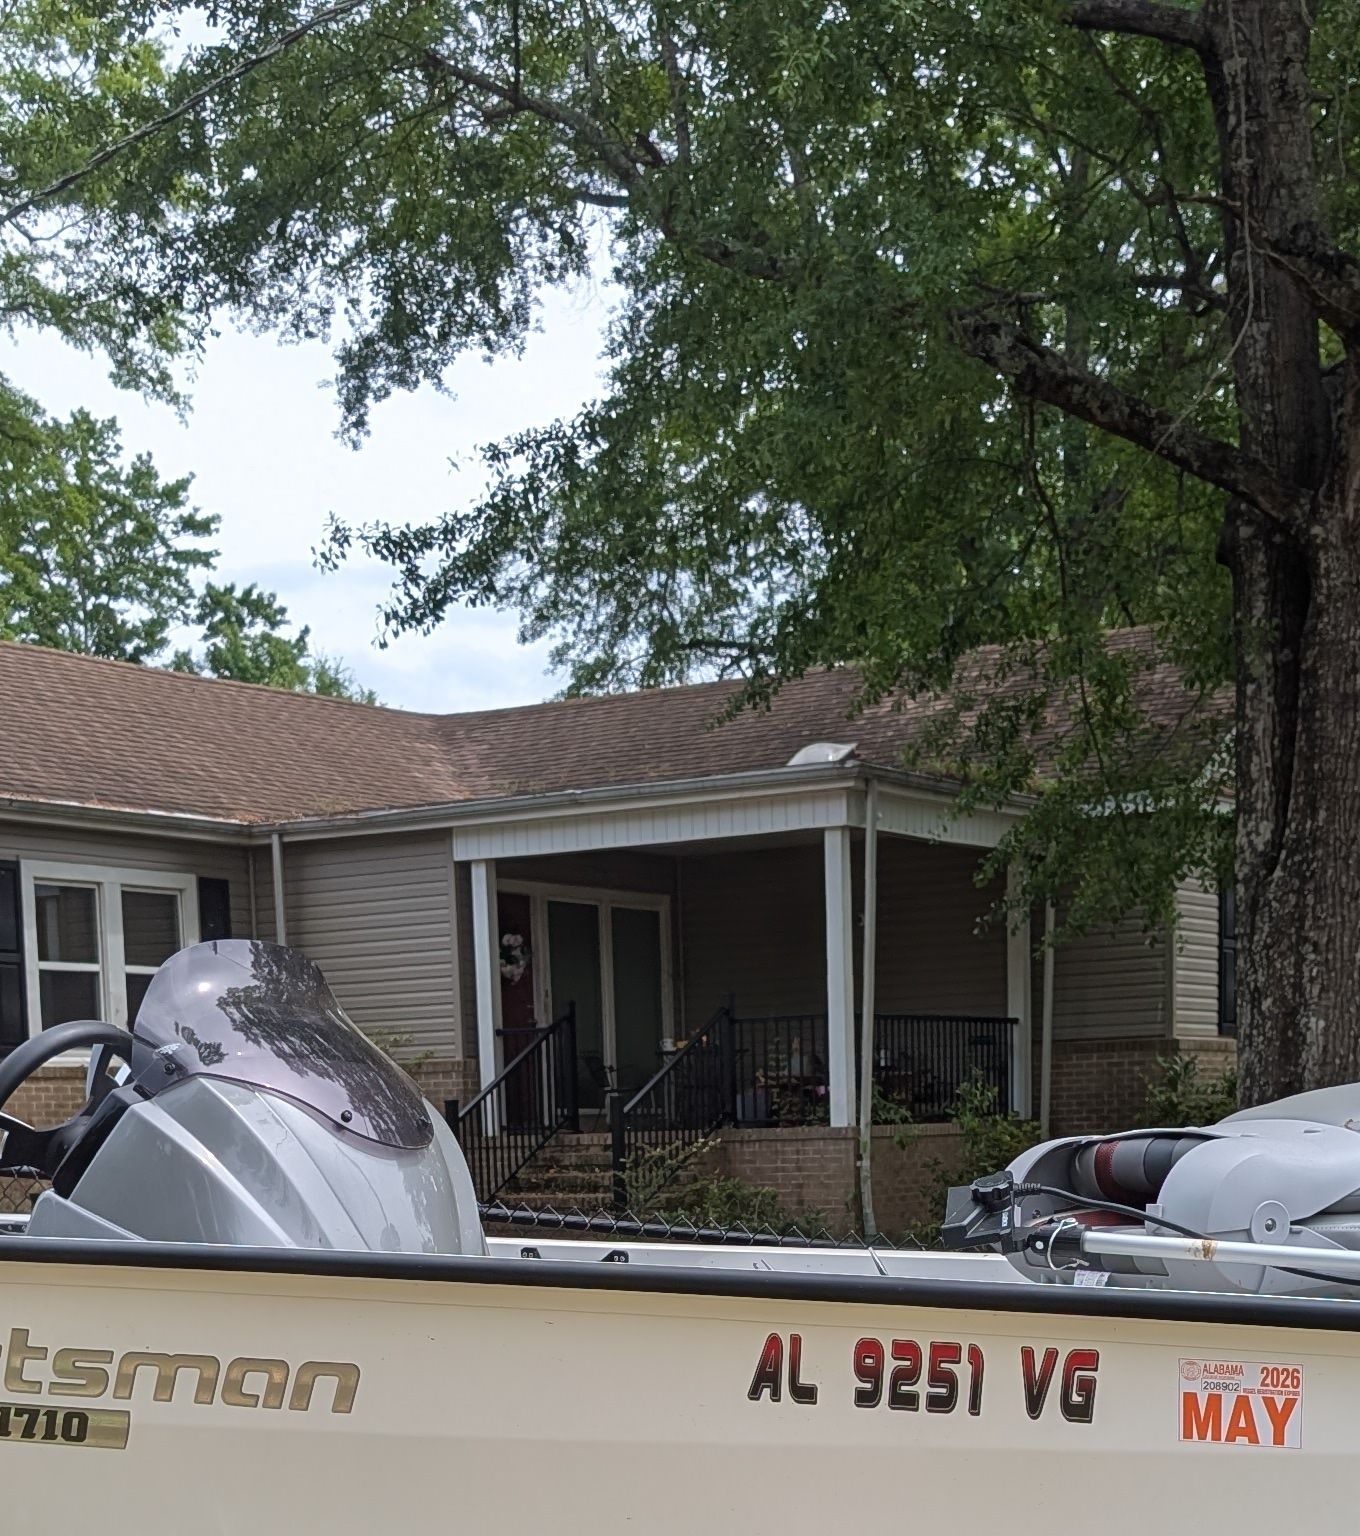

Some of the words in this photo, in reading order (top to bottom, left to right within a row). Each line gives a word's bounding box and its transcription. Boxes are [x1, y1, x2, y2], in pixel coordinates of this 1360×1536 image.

[747, 1332, 818, 1405] AL
[853, 1337, 984, 1416] 9251
[1020, 1346, 1100, 1424] VG
[1202, 1363, 1244, 1376] ALABAMA
[1260, 1366, 1300, 1389] 2026
[1183, 1391, 1299, 1446] MAY
